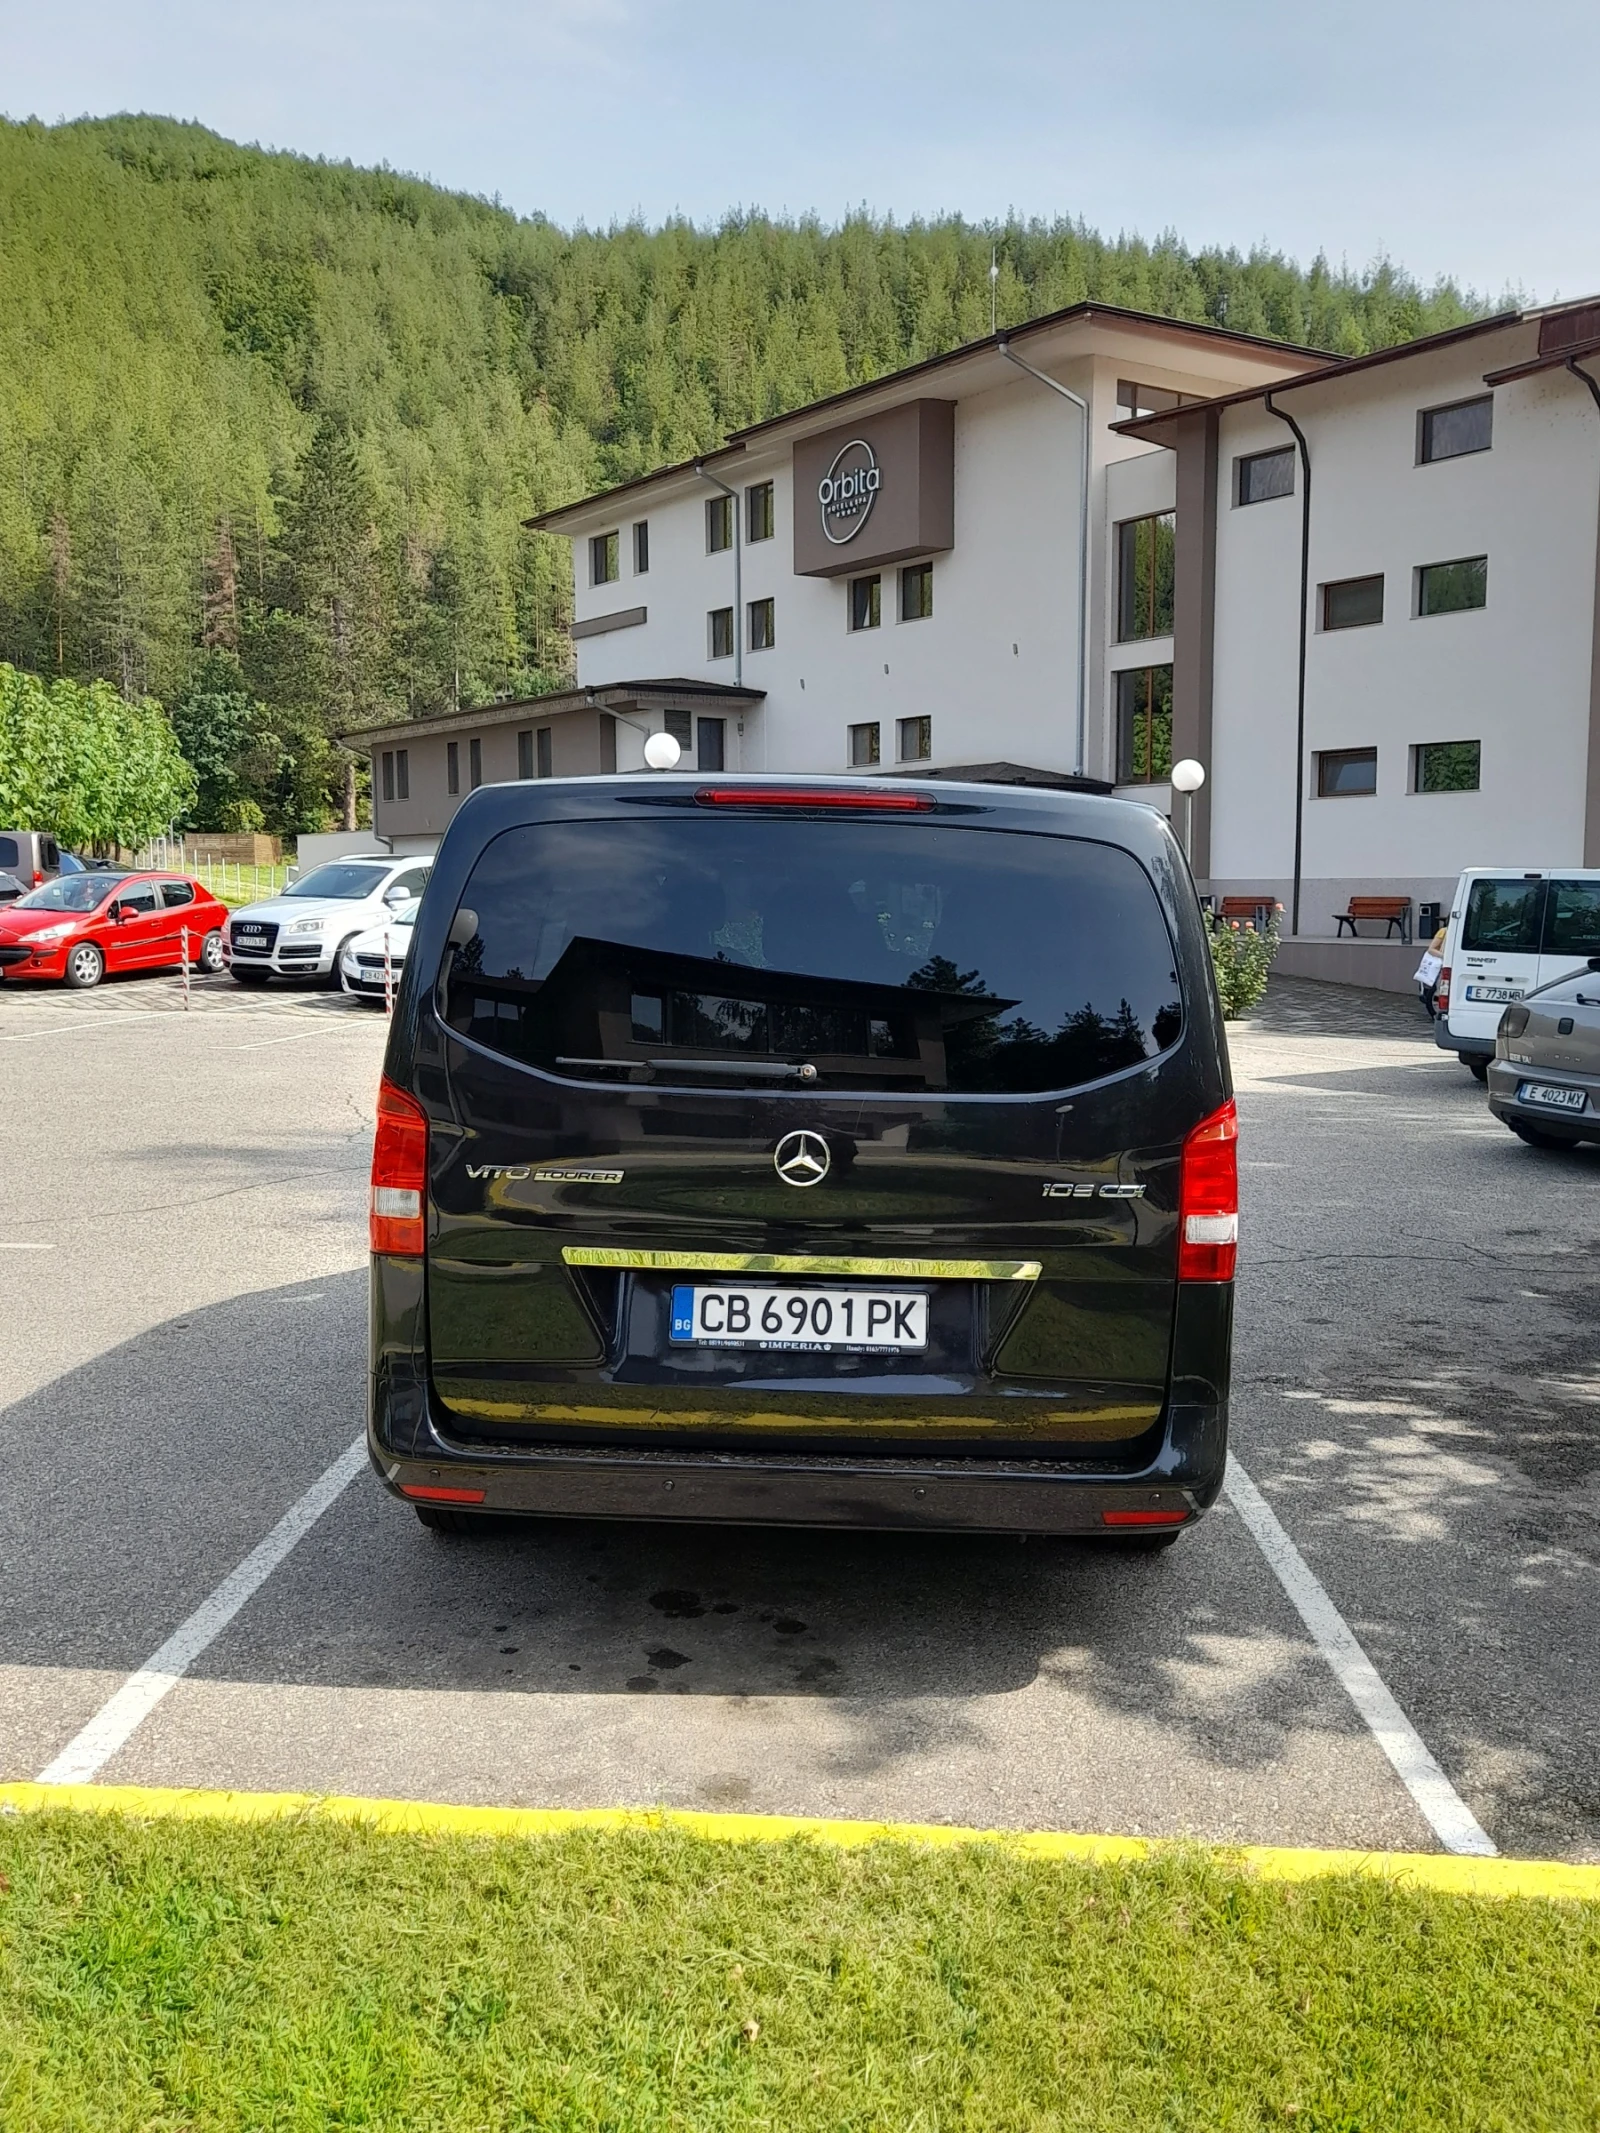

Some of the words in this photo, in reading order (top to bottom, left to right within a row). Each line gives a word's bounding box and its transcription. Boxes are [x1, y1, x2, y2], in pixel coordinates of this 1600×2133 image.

[1466, 956, 1498, 964] TRANSIT
[1475, 988, 1482, 998] E
[1529, 1086, 1539, 1099] E
[465, 1164, 530, 1180] VITO
[539, 1168, 621, 1182] TOURER
[700, 1294, 751, 1333] CB
[760, 1295, 854, 1337] 6901
[867, 1299, 918, 1340] PK
[675, 1318, 691, 1331] BG
[768, 1341, 823, 1351] IMPERIA
